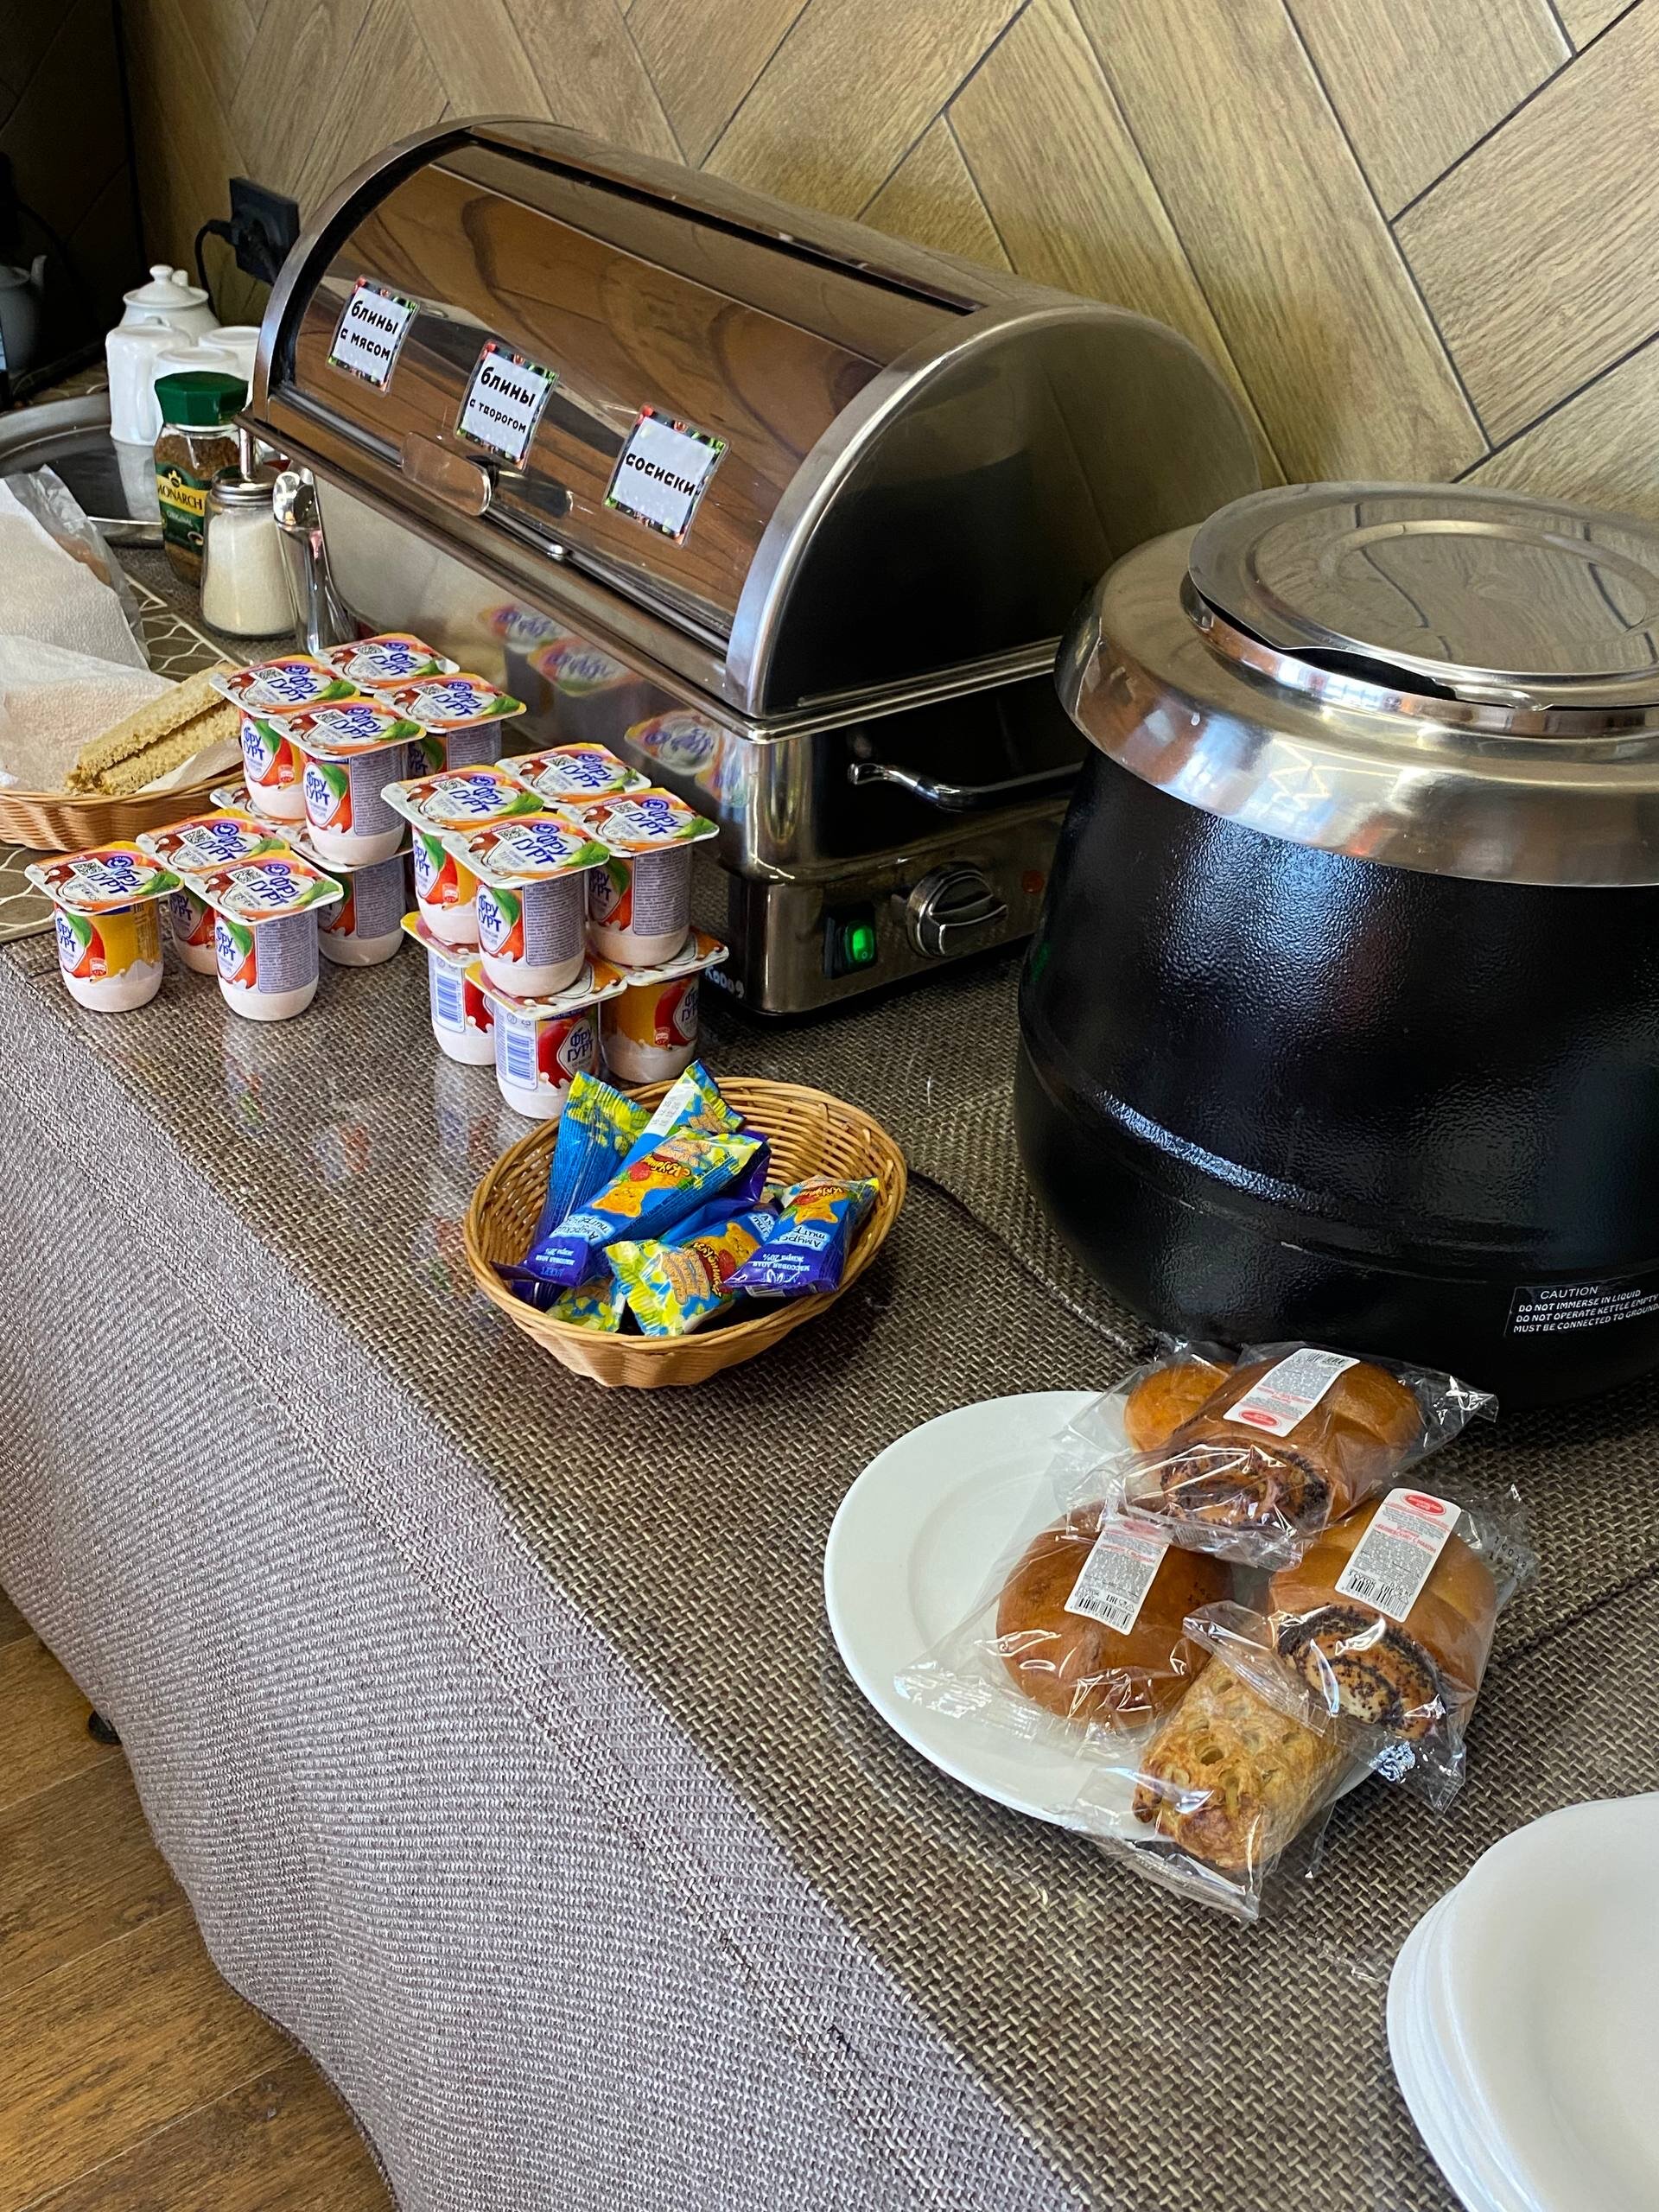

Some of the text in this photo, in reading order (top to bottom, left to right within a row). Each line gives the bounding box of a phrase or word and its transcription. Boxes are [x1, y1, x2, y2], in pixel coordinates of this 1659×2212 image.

[351, 299, 399, 335] блины
[340, 327, 392, 362] с мясом
[480, 365, 537, 407] блины
[469, 397, 527, 434] с творогом
[624, 452, 696, 497] сосиски
[1518, 1304, 1533, 1313] DO
[1534, 1302, 1554, 1312] NOT
[1556, 1297, 1599, 1310] IMMERSE
[1611, 1289, 1642, 1302] LIQUID
[1540, 1286, 1599, 1300] CAUTION
[1513, 1325, 1541, 1333] MUST
[1542, 1323, 1555, 1332] BE
[1556, 1316, 1611, 1331] CONNECTED
[1613, 1313, 1624, 1321] TO
[1516, 1314, 1530, 1323] DO
[1531, 1313, 1552, 1322] NOT
[1554, 1308, 1596, 1320] OPERATE
[1597, 1301, 1630, 1315] KETTLE
